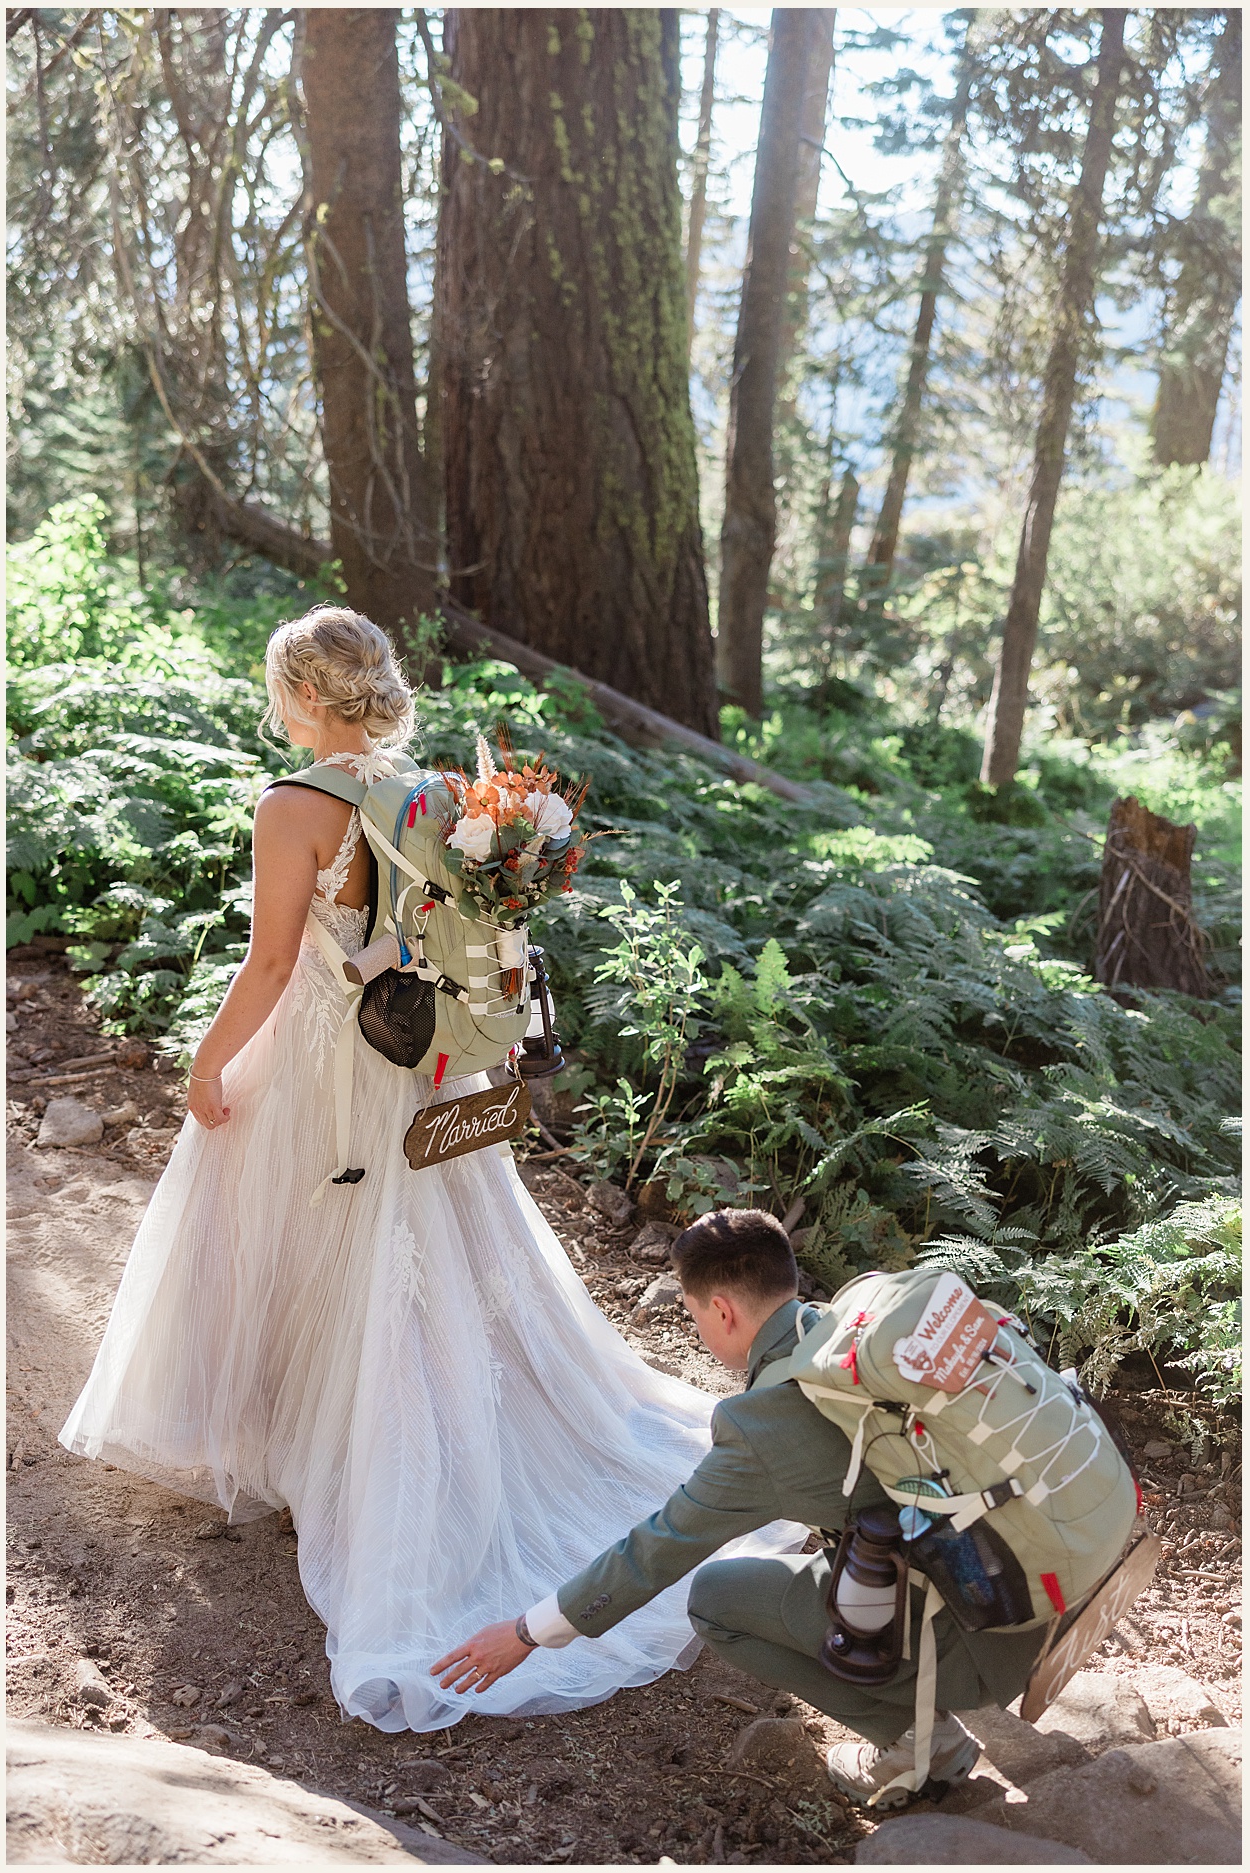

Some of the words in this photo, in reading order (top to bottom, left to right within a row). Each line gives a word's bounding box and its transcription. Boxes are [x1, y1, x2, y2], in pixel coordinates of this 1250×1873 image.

[426, 1086, 519, 1157] Married
[918, 1287, 963, 1339] Welcome
[966, 1316, 985, 1336] Sam
[961, 1335, 972, 1345] &
[1045, 1574, 1130, 1705] Just
